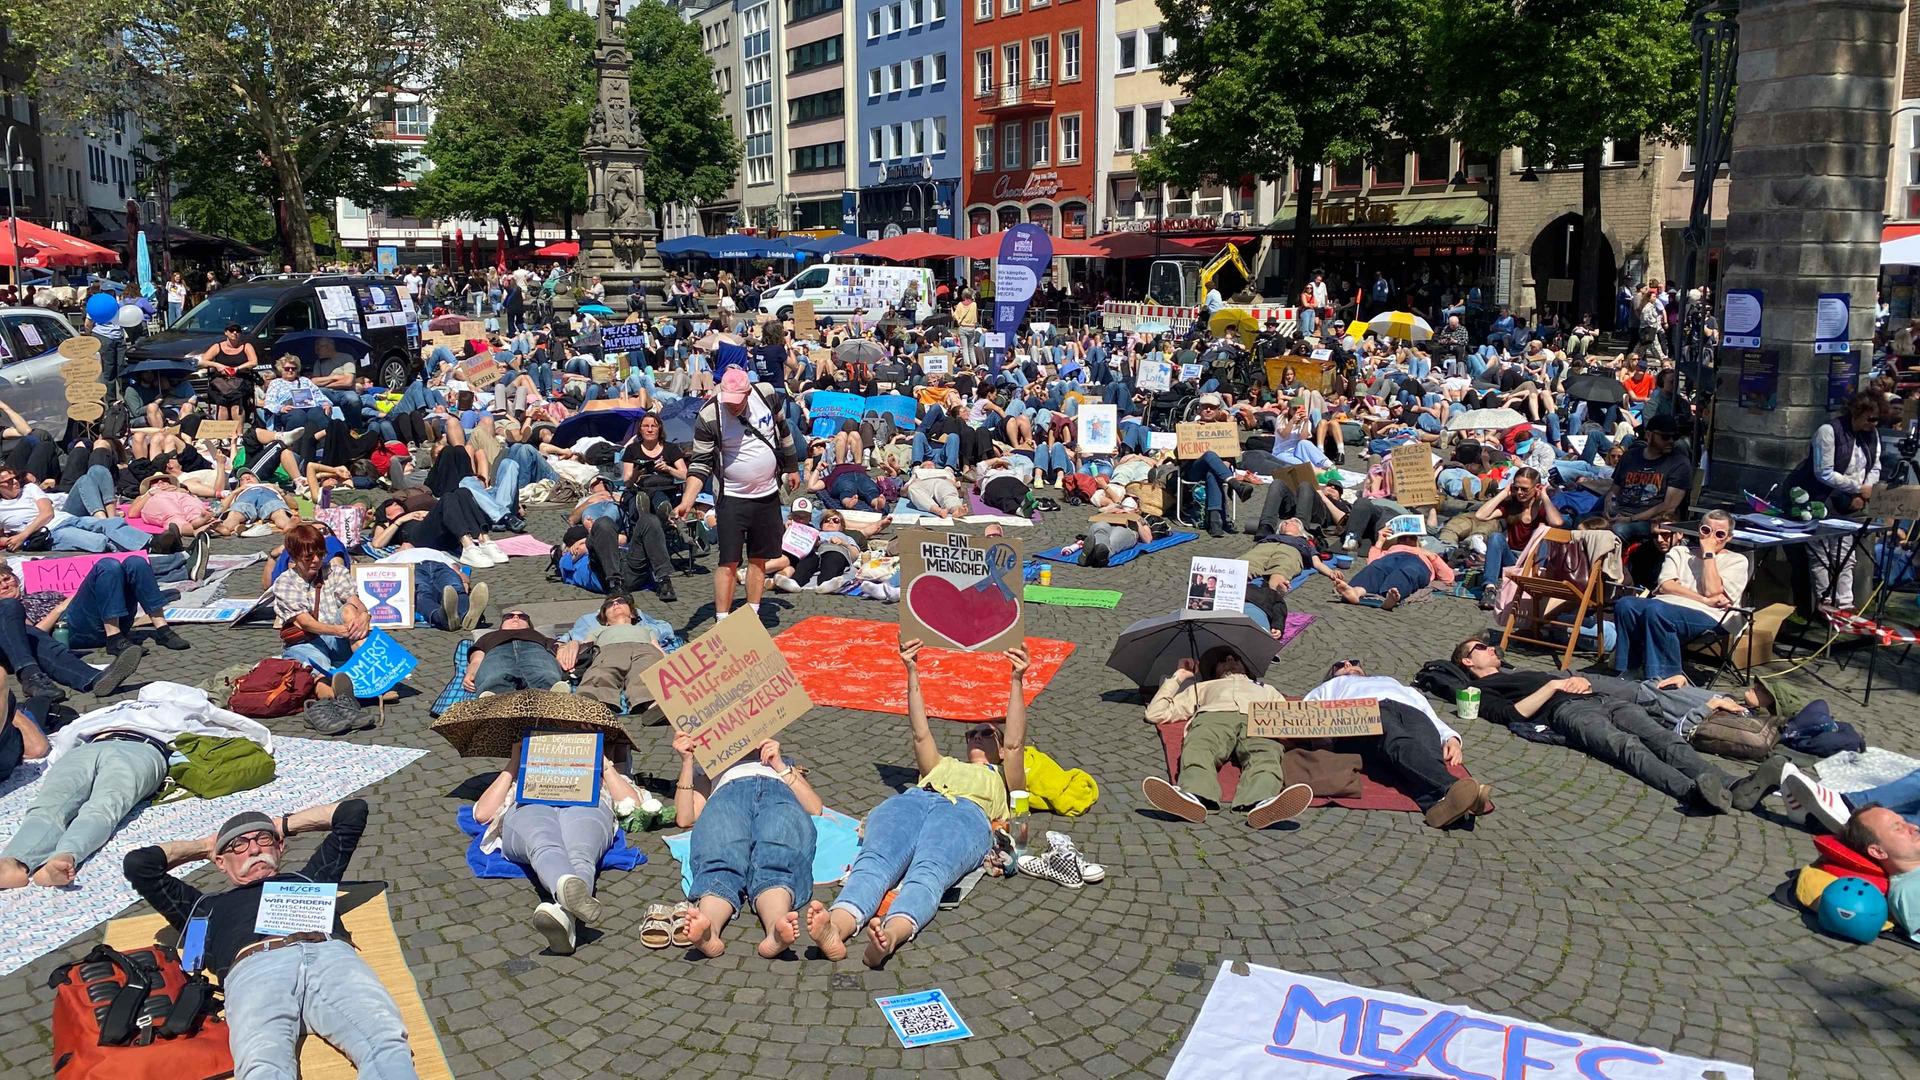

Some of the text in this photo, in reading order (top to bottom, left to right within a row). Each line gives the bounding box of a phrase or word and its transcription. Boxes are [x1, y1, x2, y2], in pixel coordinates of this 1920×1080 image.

[992, 172, 1059, 199] Chocolaterie
[23, 256, 39, 264] früh
[602, 324, 638, 335] ME/CFS
[604, 335, 644, 348] ALPTRAUM
[1196, 430, 1233, 438] KRANK
[1625, 471, 1665, 489] BERLIN
[948, 534, 967, 548] EIN
[923, 544, 983, 562] HERZ FÜR
[926, 558, 990, 576] MENSCHEN
[680, 649, 760, 705] hilfreichen
[1321, 698, 1375, 709] PISSED
[1253, 708, 1370, 719] FORSCHUNG
[1253, 718, 1328, 727] WENIGER
[530, 743, 591, 755] THERAPEUTIN
[716, 736, 752, 764] KASSEN
[280, 885, 321, 893] ME/CFS
[266, 912, 327, 920] VERSORGUNG
[263, 920, 326, 929] ANERKENNUNG
